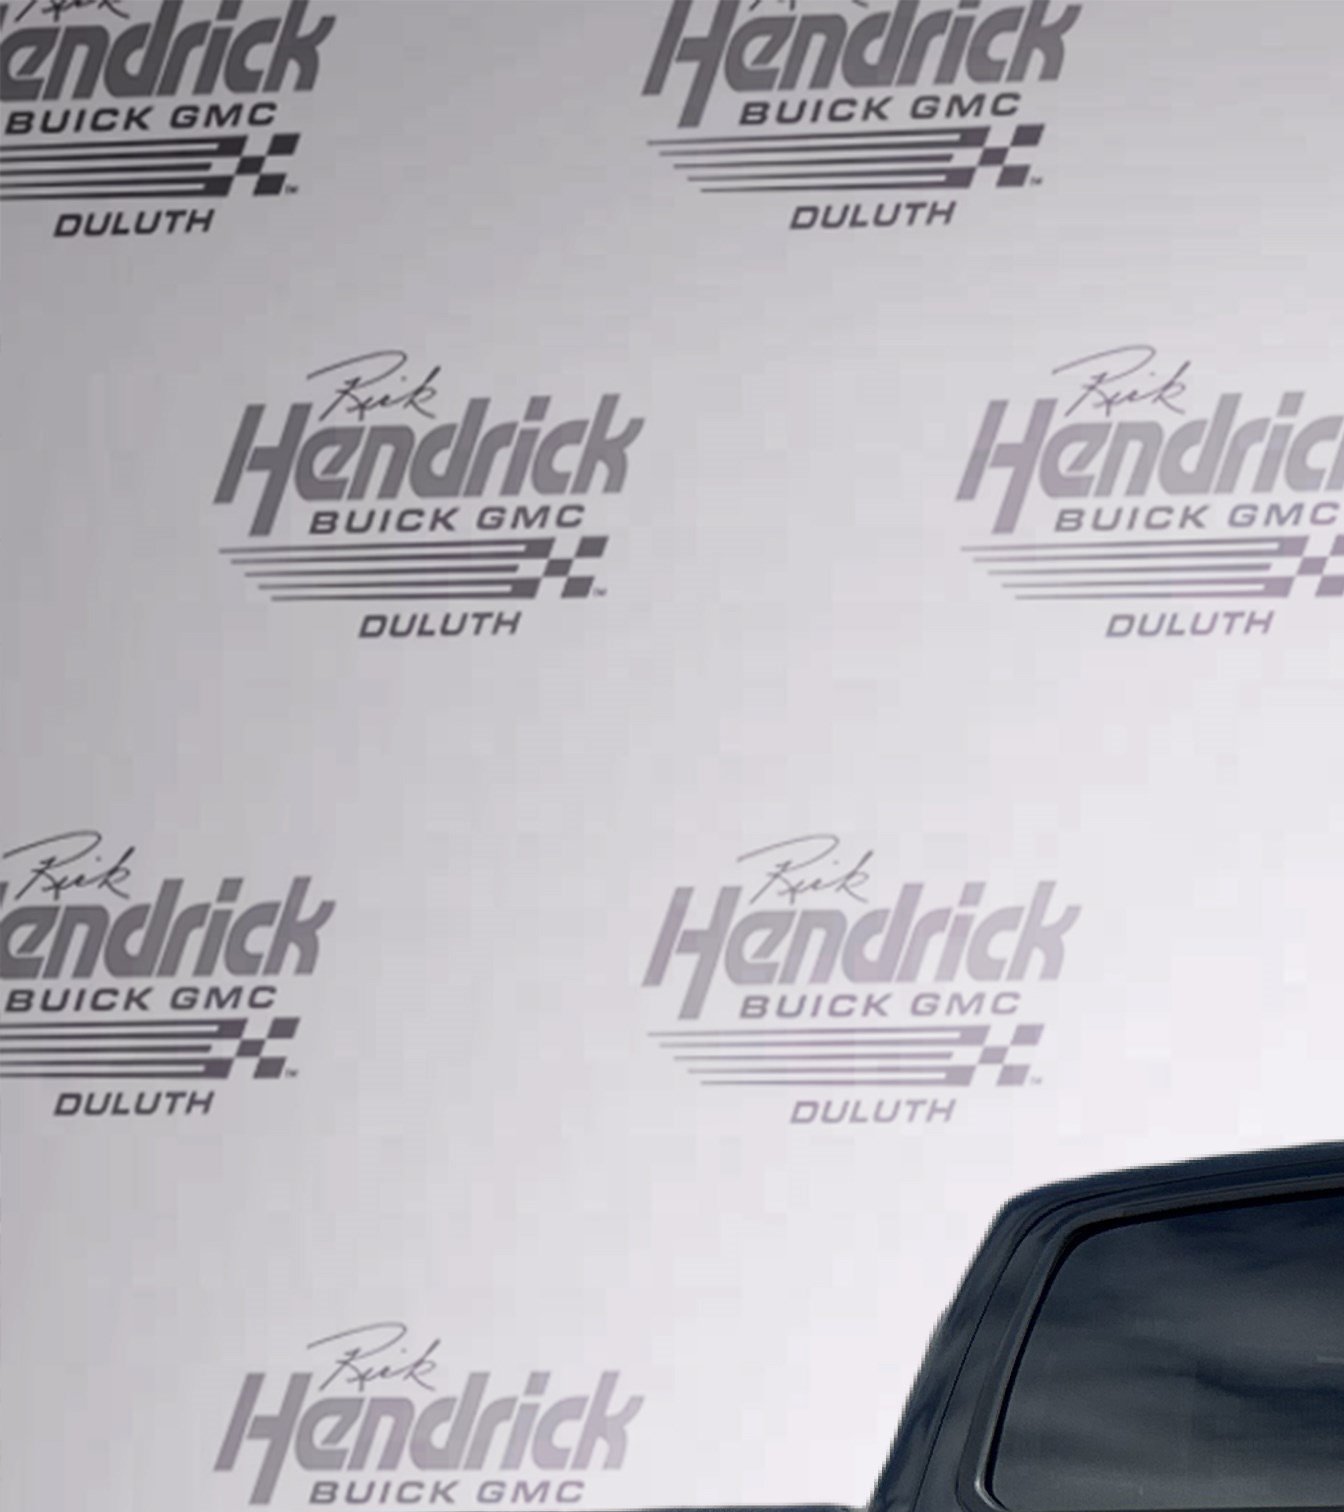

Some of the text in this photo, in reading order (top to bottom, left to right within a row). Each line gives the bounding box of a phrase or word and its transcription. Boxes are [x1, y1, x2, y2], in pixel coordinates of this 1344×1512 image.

[0, 0, 336, 102] endrick
[642, 0, 1082, 128] Hendrick
[4, 102, 277, 135] BUICK GMC
[739, 92, 1021, 126] BUICK GMC
[53, 209, 215, 238] DULUTH
[789, 201, 957, 230] DULUTH
[214, 394, 644, 537] Hendrick
[309, 504, 585, 535] BUICK GMC
[1054, 501, 1340, 532] BUICK GMC
[358, 611, 522, 638] DULUTH
[1105, 610, 1275, 638] DULUTH
[0, 876, 335, 980] endrick
[641, 880, 1081, 1021] Hendrick
[4, 985, 277, 1013] BUICK GMC
[739, 991, 1021, 1019] BUICK GMC
[54, 1091, 215, 1116] DULUTH
[790, 1098, 956, 1124] DULUTH
[213, 1371, 644, 1506] Hendrick
[308, 1480, 585, 1505] BUICK GMC
